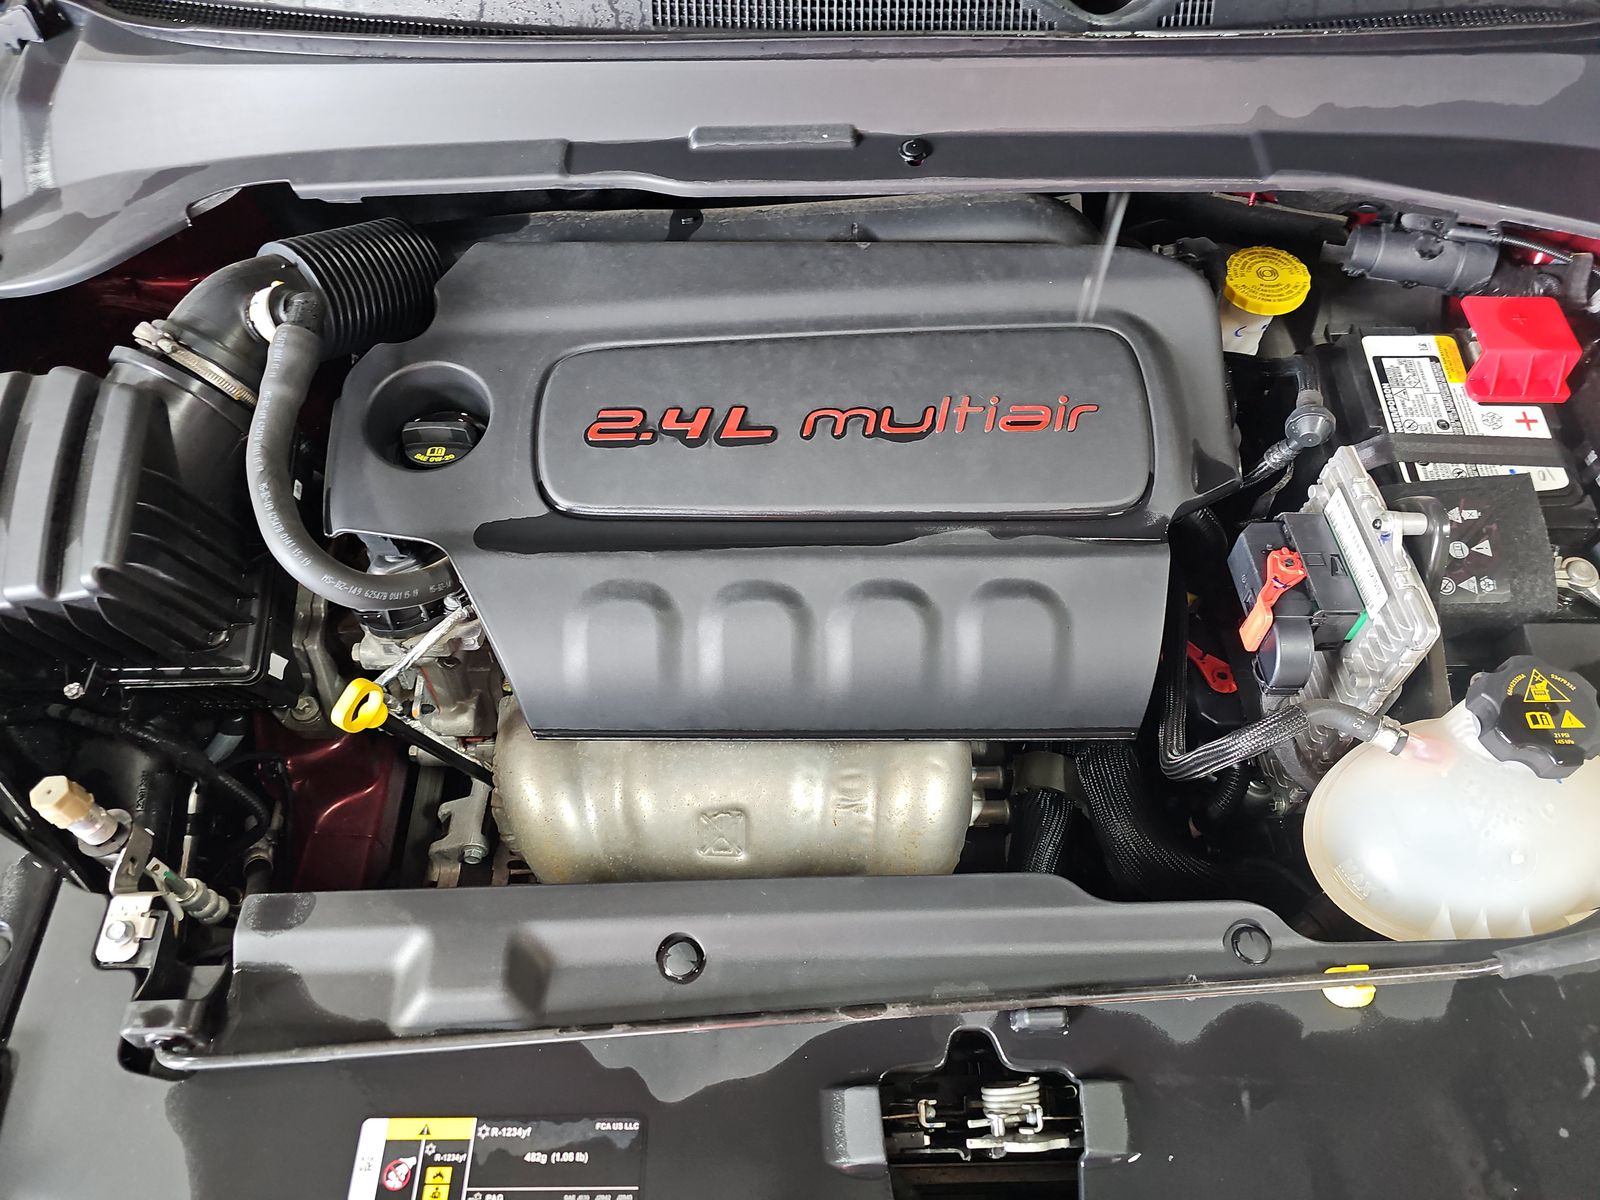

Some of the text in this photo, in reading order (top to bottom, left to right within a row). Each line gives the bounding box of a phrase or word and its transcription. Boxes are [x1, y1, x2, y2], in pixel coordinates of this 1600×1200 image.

[802, 395, 1099, 437] multiair
[491, 1121, 640, 1139] R-1234yf FCA US LLC
